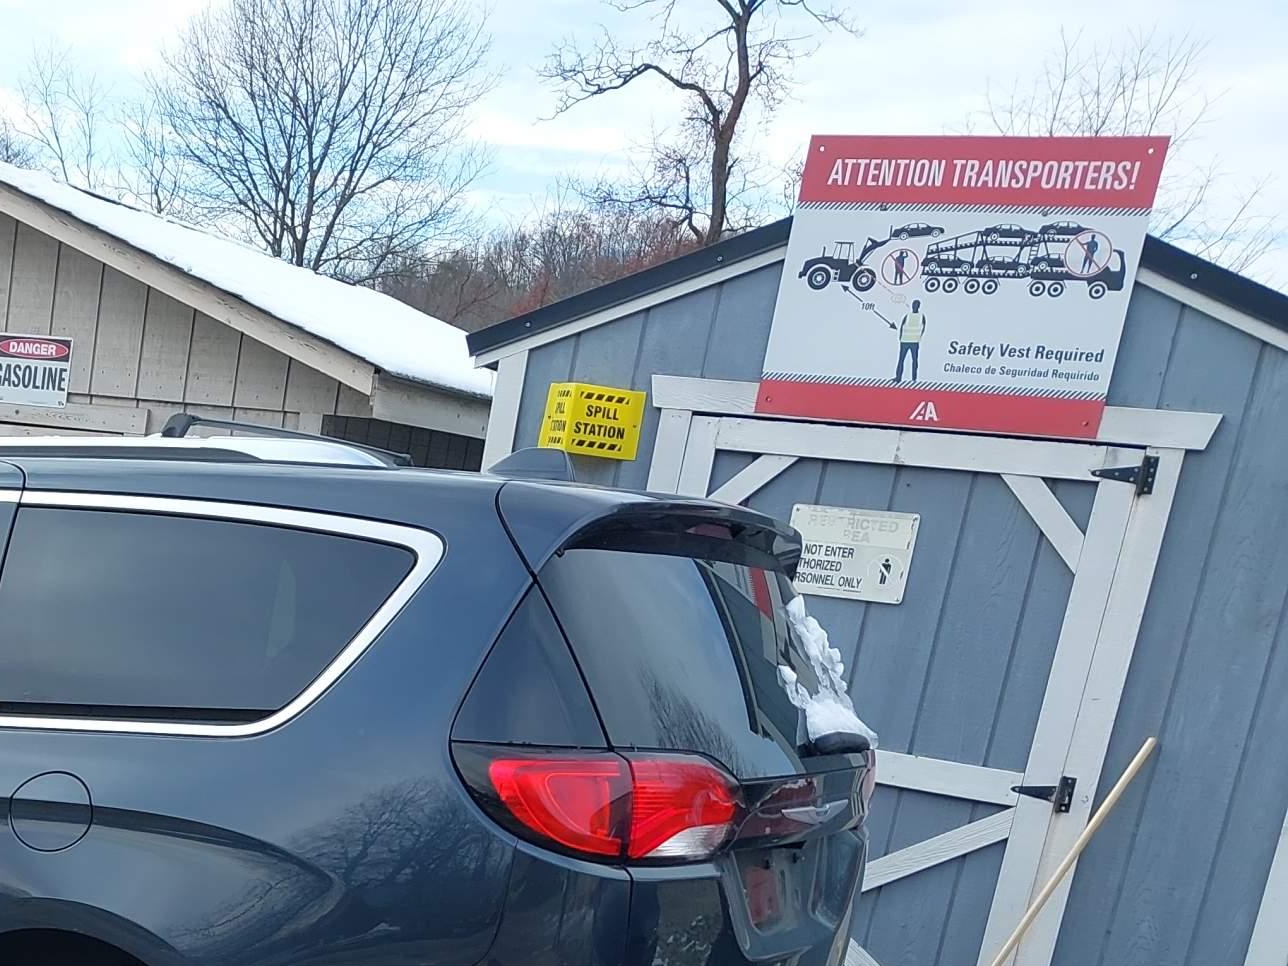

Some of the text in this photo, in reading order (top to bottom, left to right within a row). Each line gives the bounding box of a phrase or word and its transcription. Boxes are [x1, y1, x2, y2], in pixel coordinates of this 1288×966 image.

[827, 158, 1142, 191] ATTENTION TRANSPORTERS!
[9, 341, 57, 356] DANGER
[948, 340, 1105, 365] Safety Vest Required
[943, 362, 1100, 382] Chaleco de Seguridad Requirido
[585, 404, 619, 421] SPILL
[573, 421, 626, 440] STATION
[803, 543, 855, 559] NOT ENTER
[798, 557, 842, 572] THORIZED
[793, 571, 863, 589] RSONNEL ONLY
